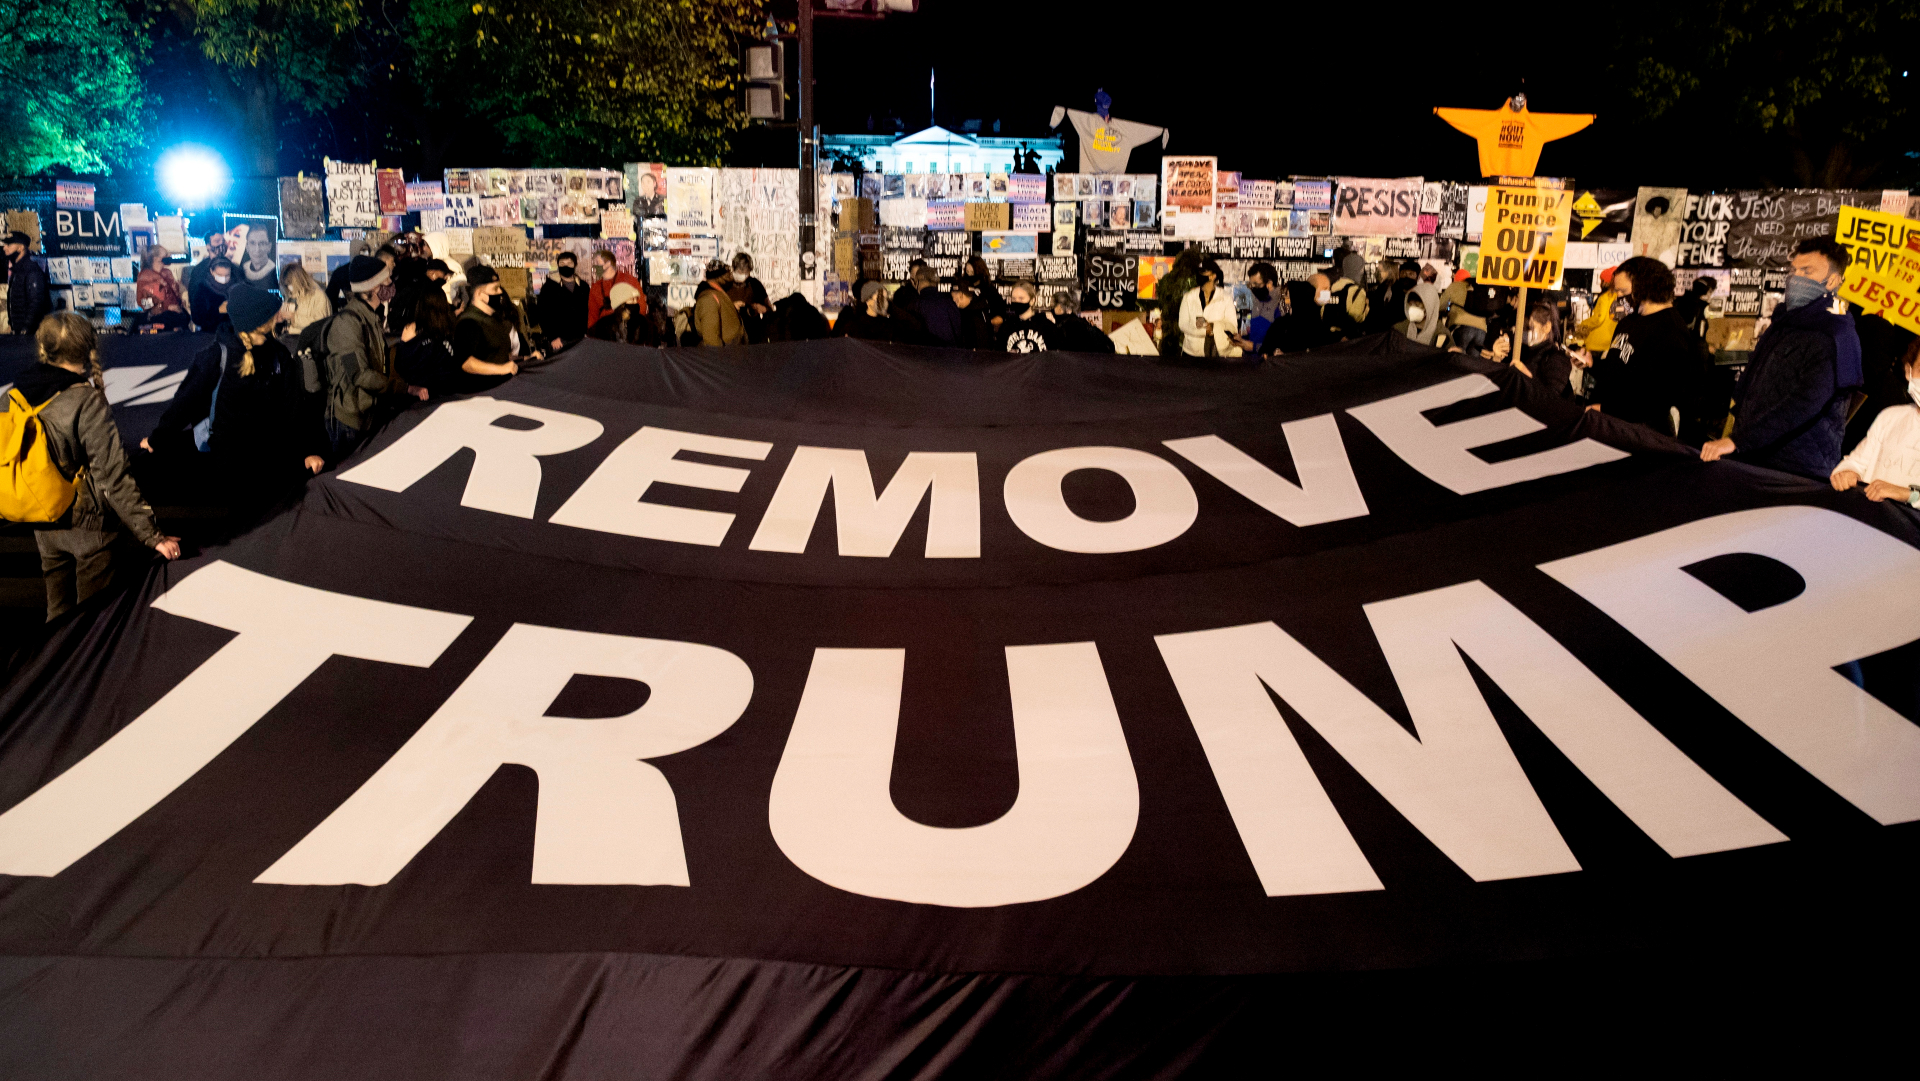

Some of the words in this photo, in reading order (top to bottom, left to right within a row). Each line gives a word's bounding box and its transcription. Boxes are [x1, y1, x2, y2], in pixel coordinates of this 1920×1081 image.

[329, 188, 375, 200] JUSTICE
[1243, 183, 1273, 192] BLACK
[1335, 186, 1421, 219] RESIST
[1496, 189, 1565, 211] Trump/
[1017, 206, 1048, 214] BLACK
[1684, 194, 1733, 221] FUCK
[1736, 196, 1786, 220] JESUS
[56, 210, 120, 238] BLM
[1497, 208, 1557, 227] Pence
[1681, 220, 1731, 244] YOUR
[1754, 222, 1785, 236] NEED
[937, 231, 967, 245] TRUMP
[1234, 237, 1271, 248] REMOVE
[1277, 237, 1311, 248] REMOVE
[1496, 228, 1553, 255] OUT
[60, 242, 121, 252] #blacklivesmatter
[934, 244, 943, 254] IS
[945, 243, 971, 255] UNFIT
[1241, 247, 1264, 258] HATE
[1279, 247, 1308, 257] TRUMP
[1733, 237, 1788, 265] Thoughts
[883, 254, 910, 265] TRUMP
[1677, 243, 1725, 267] FENCE
[491, 260, 525, 268] CONFUSIO
[1090, 255, 1135, 278] STOP
[1481, 256, 1558, 284] NOW!
[1766, 273, 1787, 281] DEMOC
[1087, 278, 1135, 293] KILLING
[1098, 291, 1123, 308] US
[1731, 292, 1757, 302] TRUMP
[1726, 302, 1734, 311] IS
[1735, 301, 1760, 312] UNFIT
[336, 374, 1632, 559] REMOVE
[0, 505, 1920, 909] TRUMP
